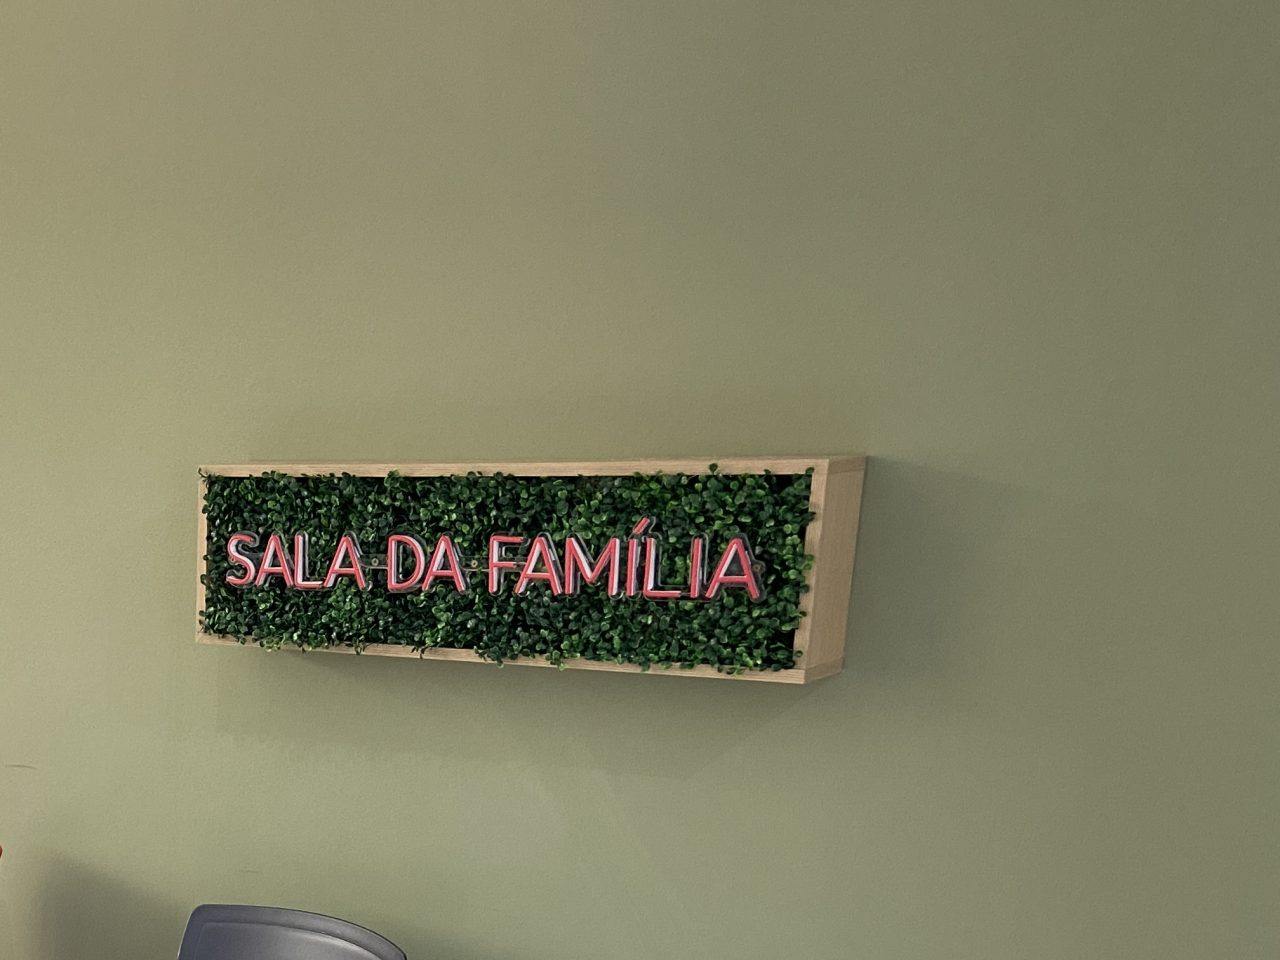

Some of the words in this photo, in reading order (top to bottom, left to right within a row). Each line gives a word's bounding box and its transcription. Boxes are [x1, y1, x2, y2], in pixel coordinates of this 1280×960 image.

[226, 533, 368, 591] SALA
[387, 534, 467, 593] DA
[487, 517, 761, 599] FAMÍLIA
